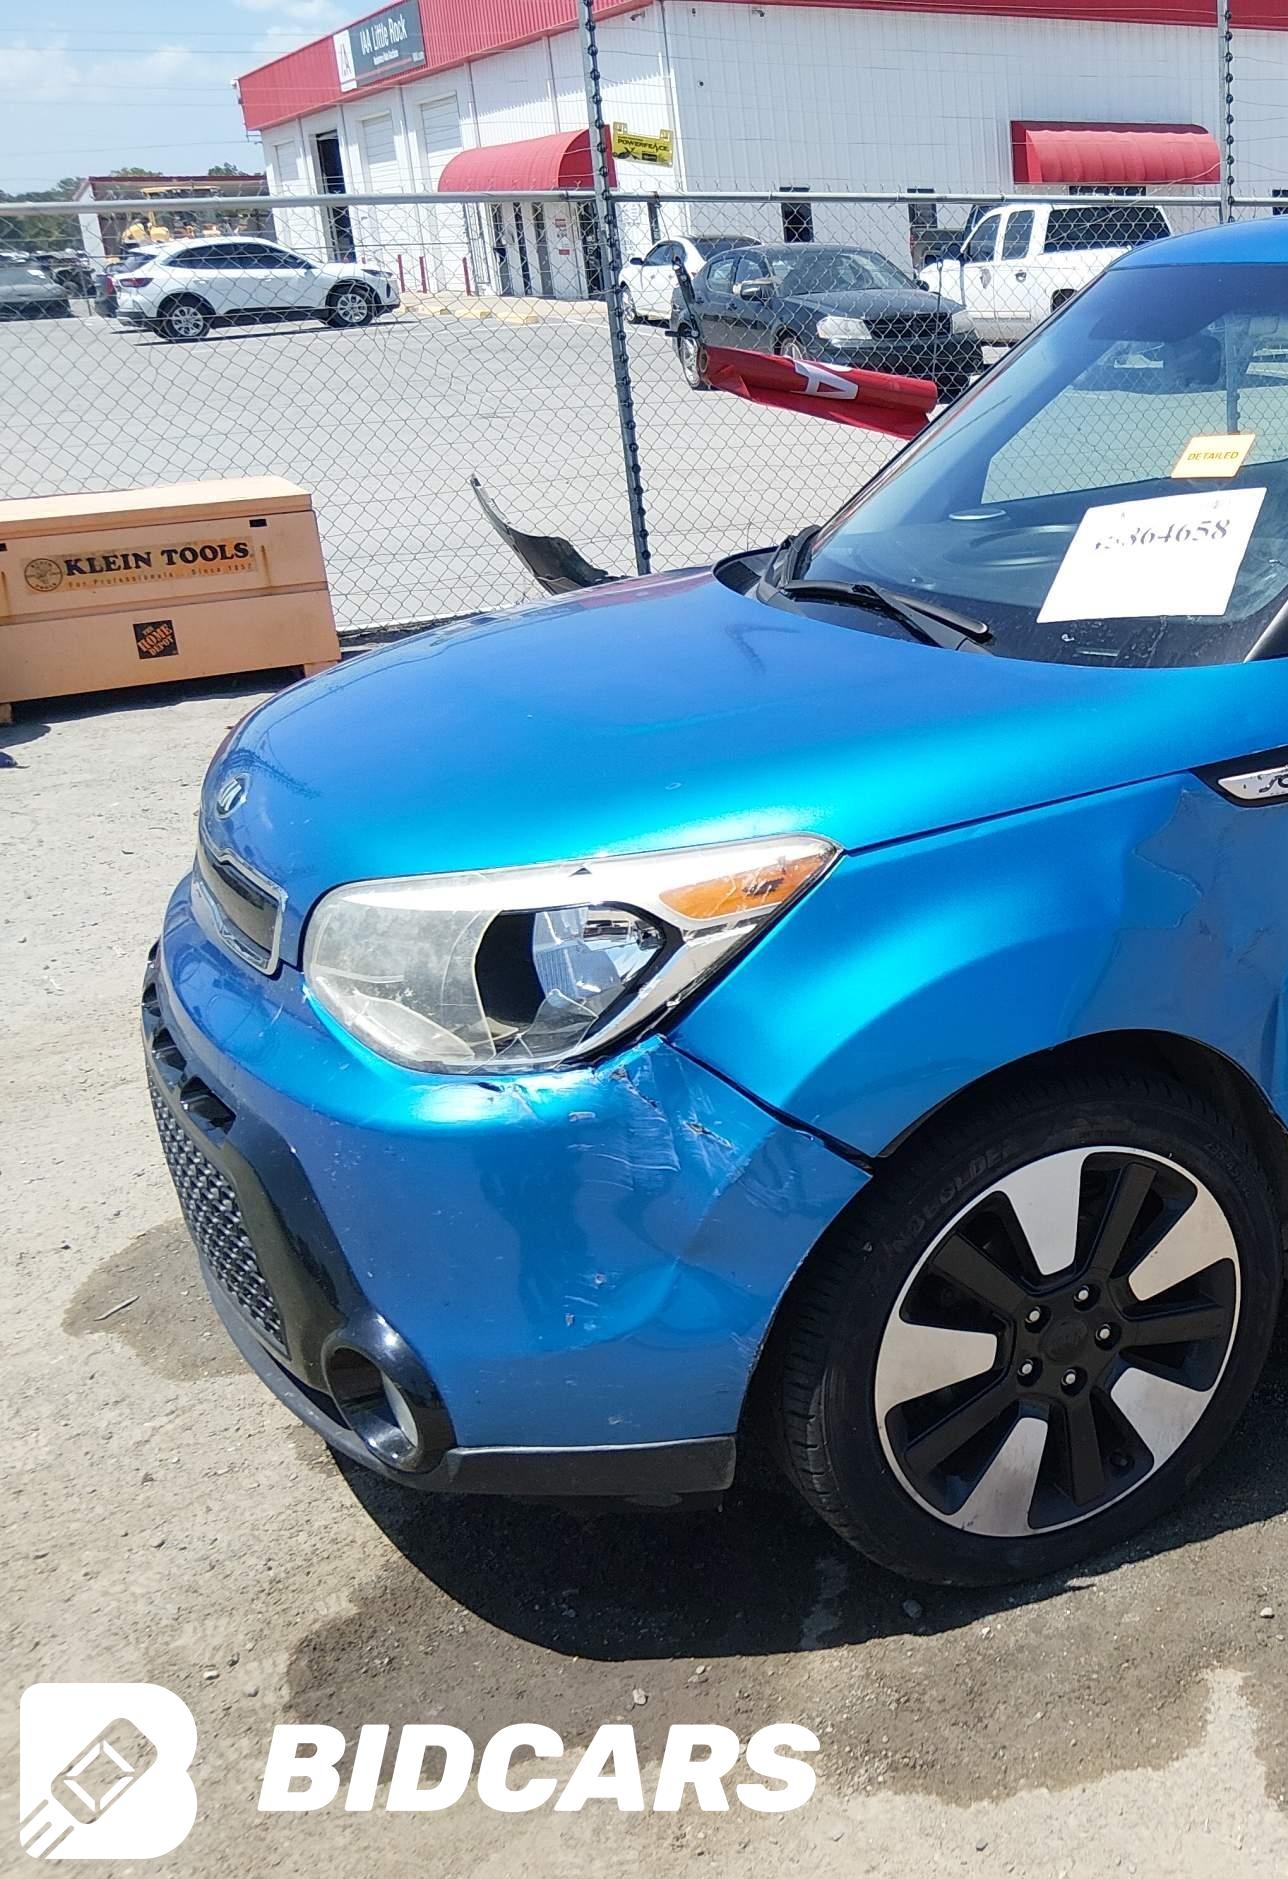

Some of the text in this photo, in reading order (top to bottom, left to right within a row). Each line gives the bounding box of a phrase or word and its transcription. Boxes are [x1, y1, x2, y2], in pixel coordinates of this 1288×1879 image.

[371, 22, 390, 51] Little
[388, 13, 408, 44] Rock
[1186, 450, 1239, 462] DETAILED
[64, 541, 249, 577] KLEIN TOOLS
[137, 623, 173, 652] HOME
[148, 635, 174, 656] DEPOT
